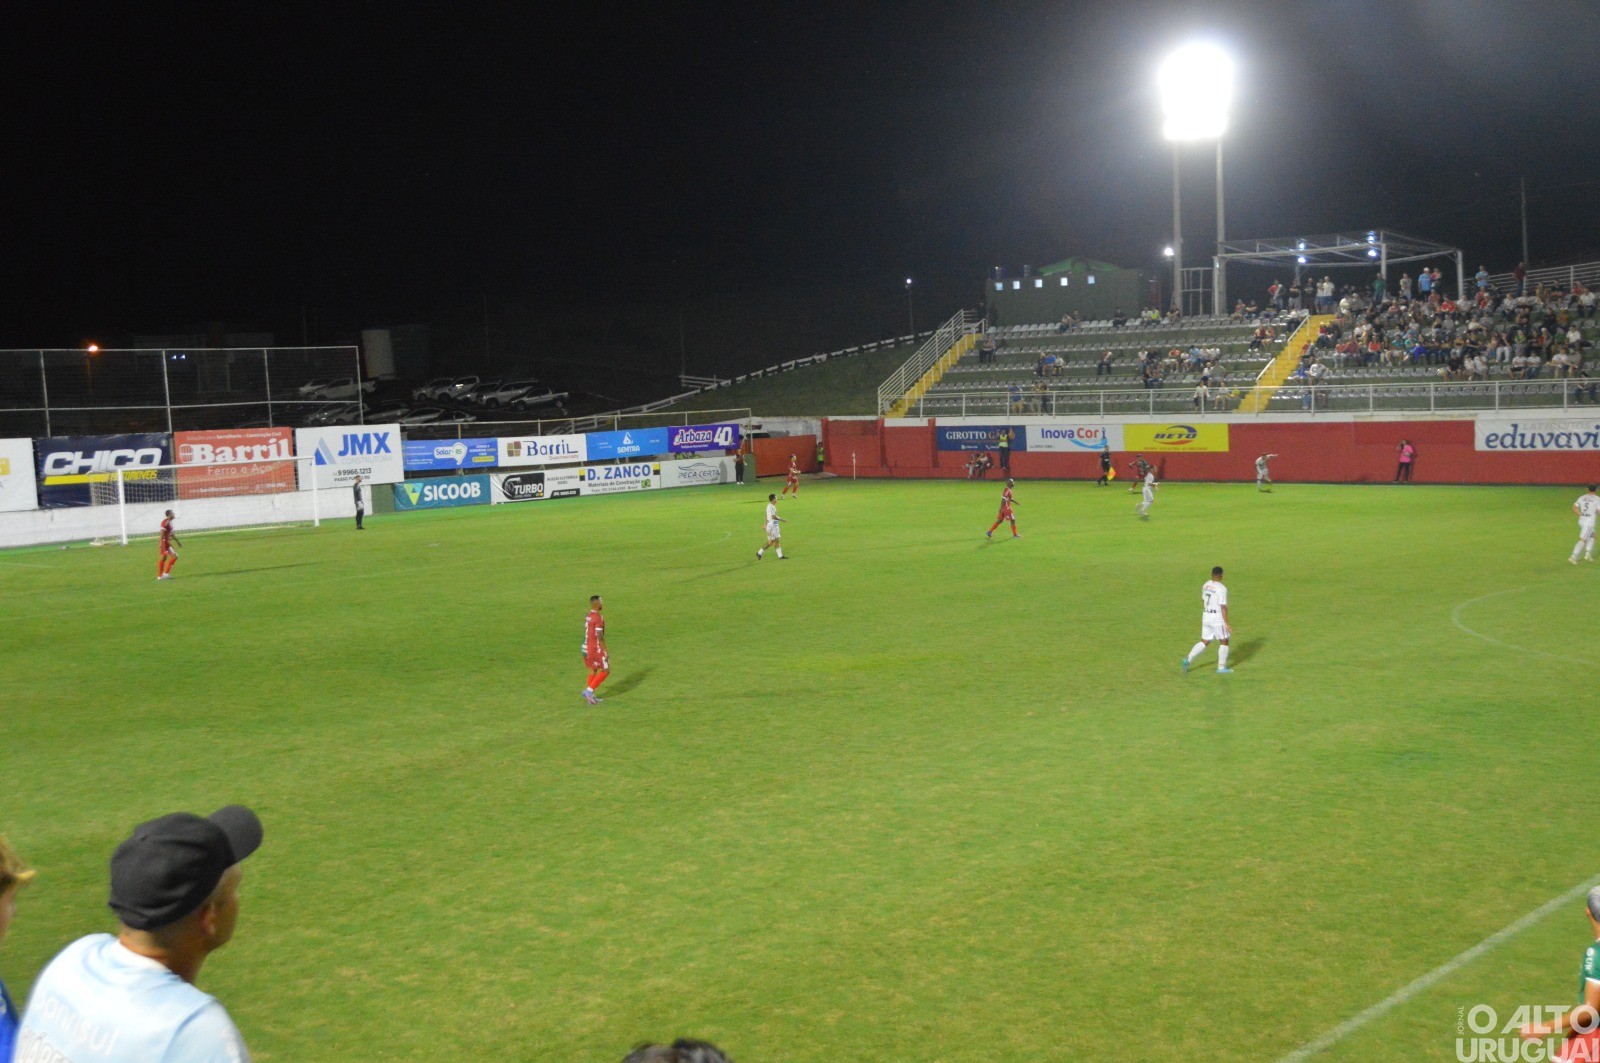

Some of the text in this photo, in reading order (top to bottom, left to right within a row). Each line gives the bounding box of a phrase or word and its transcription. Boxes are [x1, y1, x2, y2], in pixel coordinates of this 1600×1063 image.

[674, 429, 711, 444] Arbaza
[946, 431, 987, 440] GIROTTO
[1041, 427, 1099, 440] Inova Cor
[191, 438, 293, 463] Barril
[338, 432, 391, 457] JMX
[44, 448, 162, 476] CHICO
[208, 465, 237, 476] Ferro
[251, 463, 272, 474] Aço
[588, 464, 650, 481] D. ZANCO
[678, 469, 720, 480] PEÇA CERTA
[423, 482, 481, 501] SICOOB
[514, 483, 543, 494] TURBO
[1583, 503, 1589, 511] 5
[1205, 593, 1211, 606] 7
